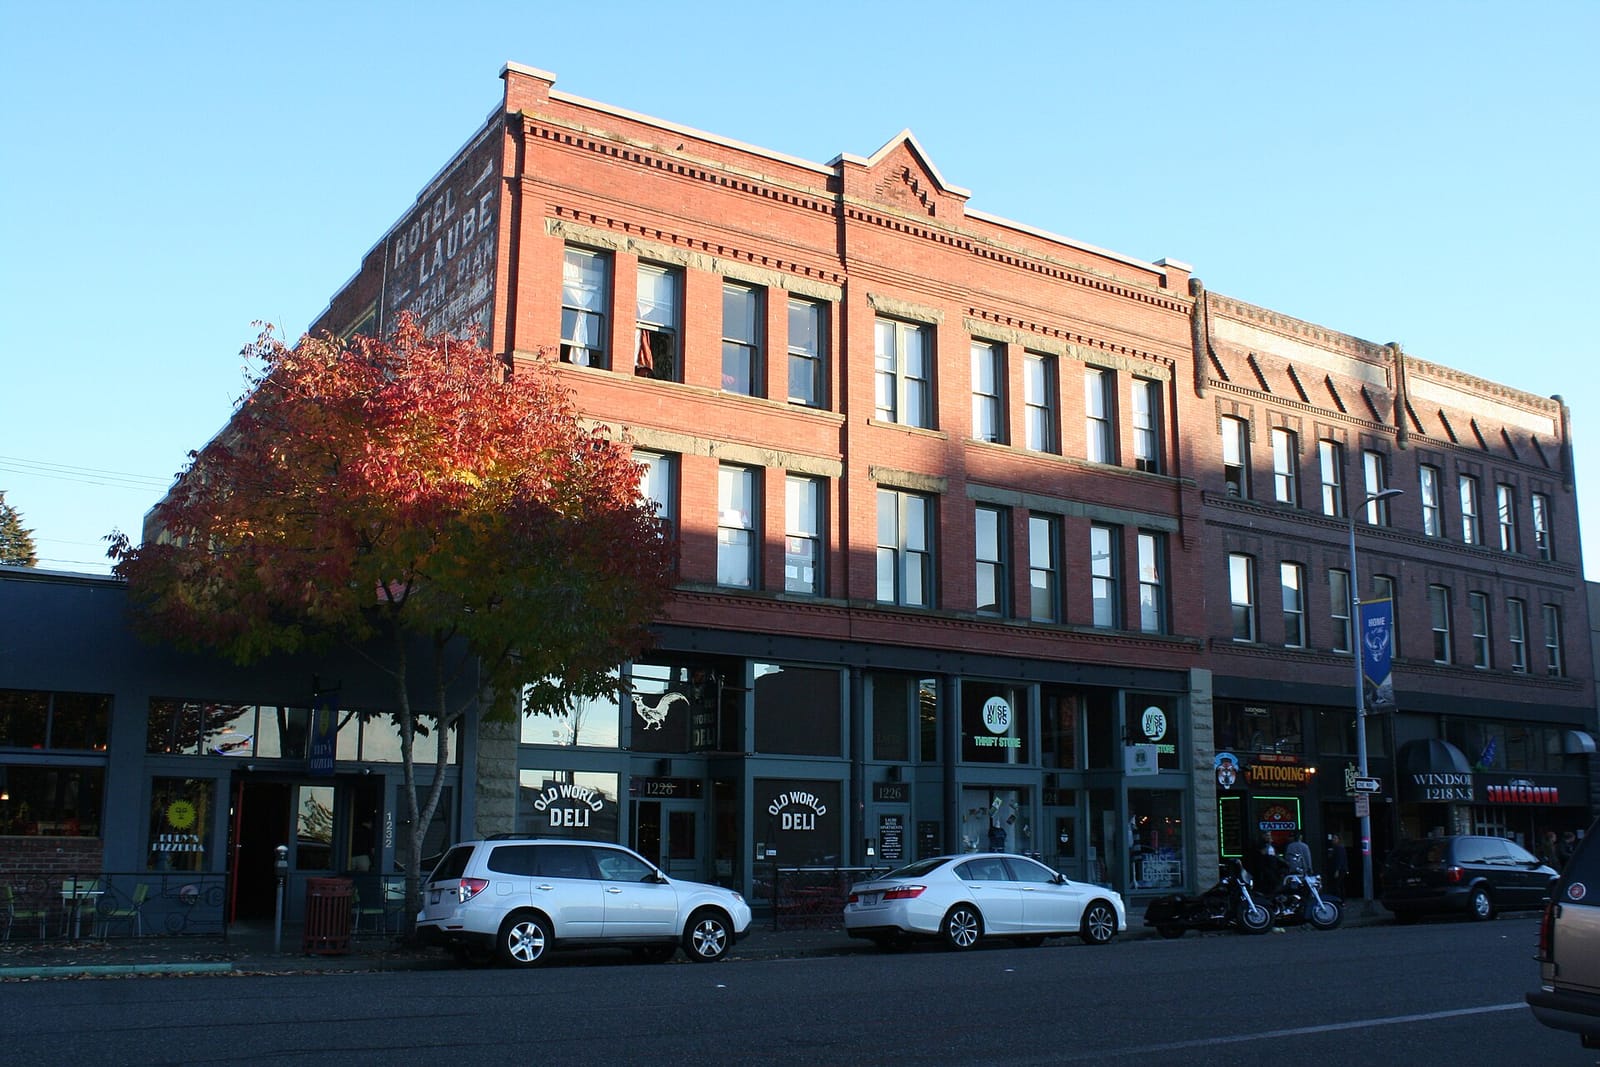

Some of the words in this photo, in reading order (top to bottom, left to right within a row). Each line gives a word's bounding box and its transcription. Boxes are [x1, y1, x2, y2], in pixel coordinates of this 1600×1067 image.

[394, 187, 455, 269] HOTEL
[419, 191, 493, 286] LAUBE
[1368, 617, 1386, 627] HOME
[974, 736, 998, 747] THRIFT
[999, 737, 1021, 748] STORE
[1251, 765, 1304, 781] TATTOOING
[646, 782, 673, 795] 1228
[880, 787, 901, 799] 1226
[1425, 787, 1453, 800] 1218
[1487, 785, 1559, 803] SHAKEDOWN
[534, 787, 558, 811] OLD
[560, 785, 603, 812] WORLD
[768, 793, 789, 816] OLD
[789, 791, 827, 816] WORLD
[550, 808, 590, 827] DELI
[782, 813, 815, 830] DELI
[385, 812, 393, 848] 1232
[152, 843, 205, 852] PIZZERIA
